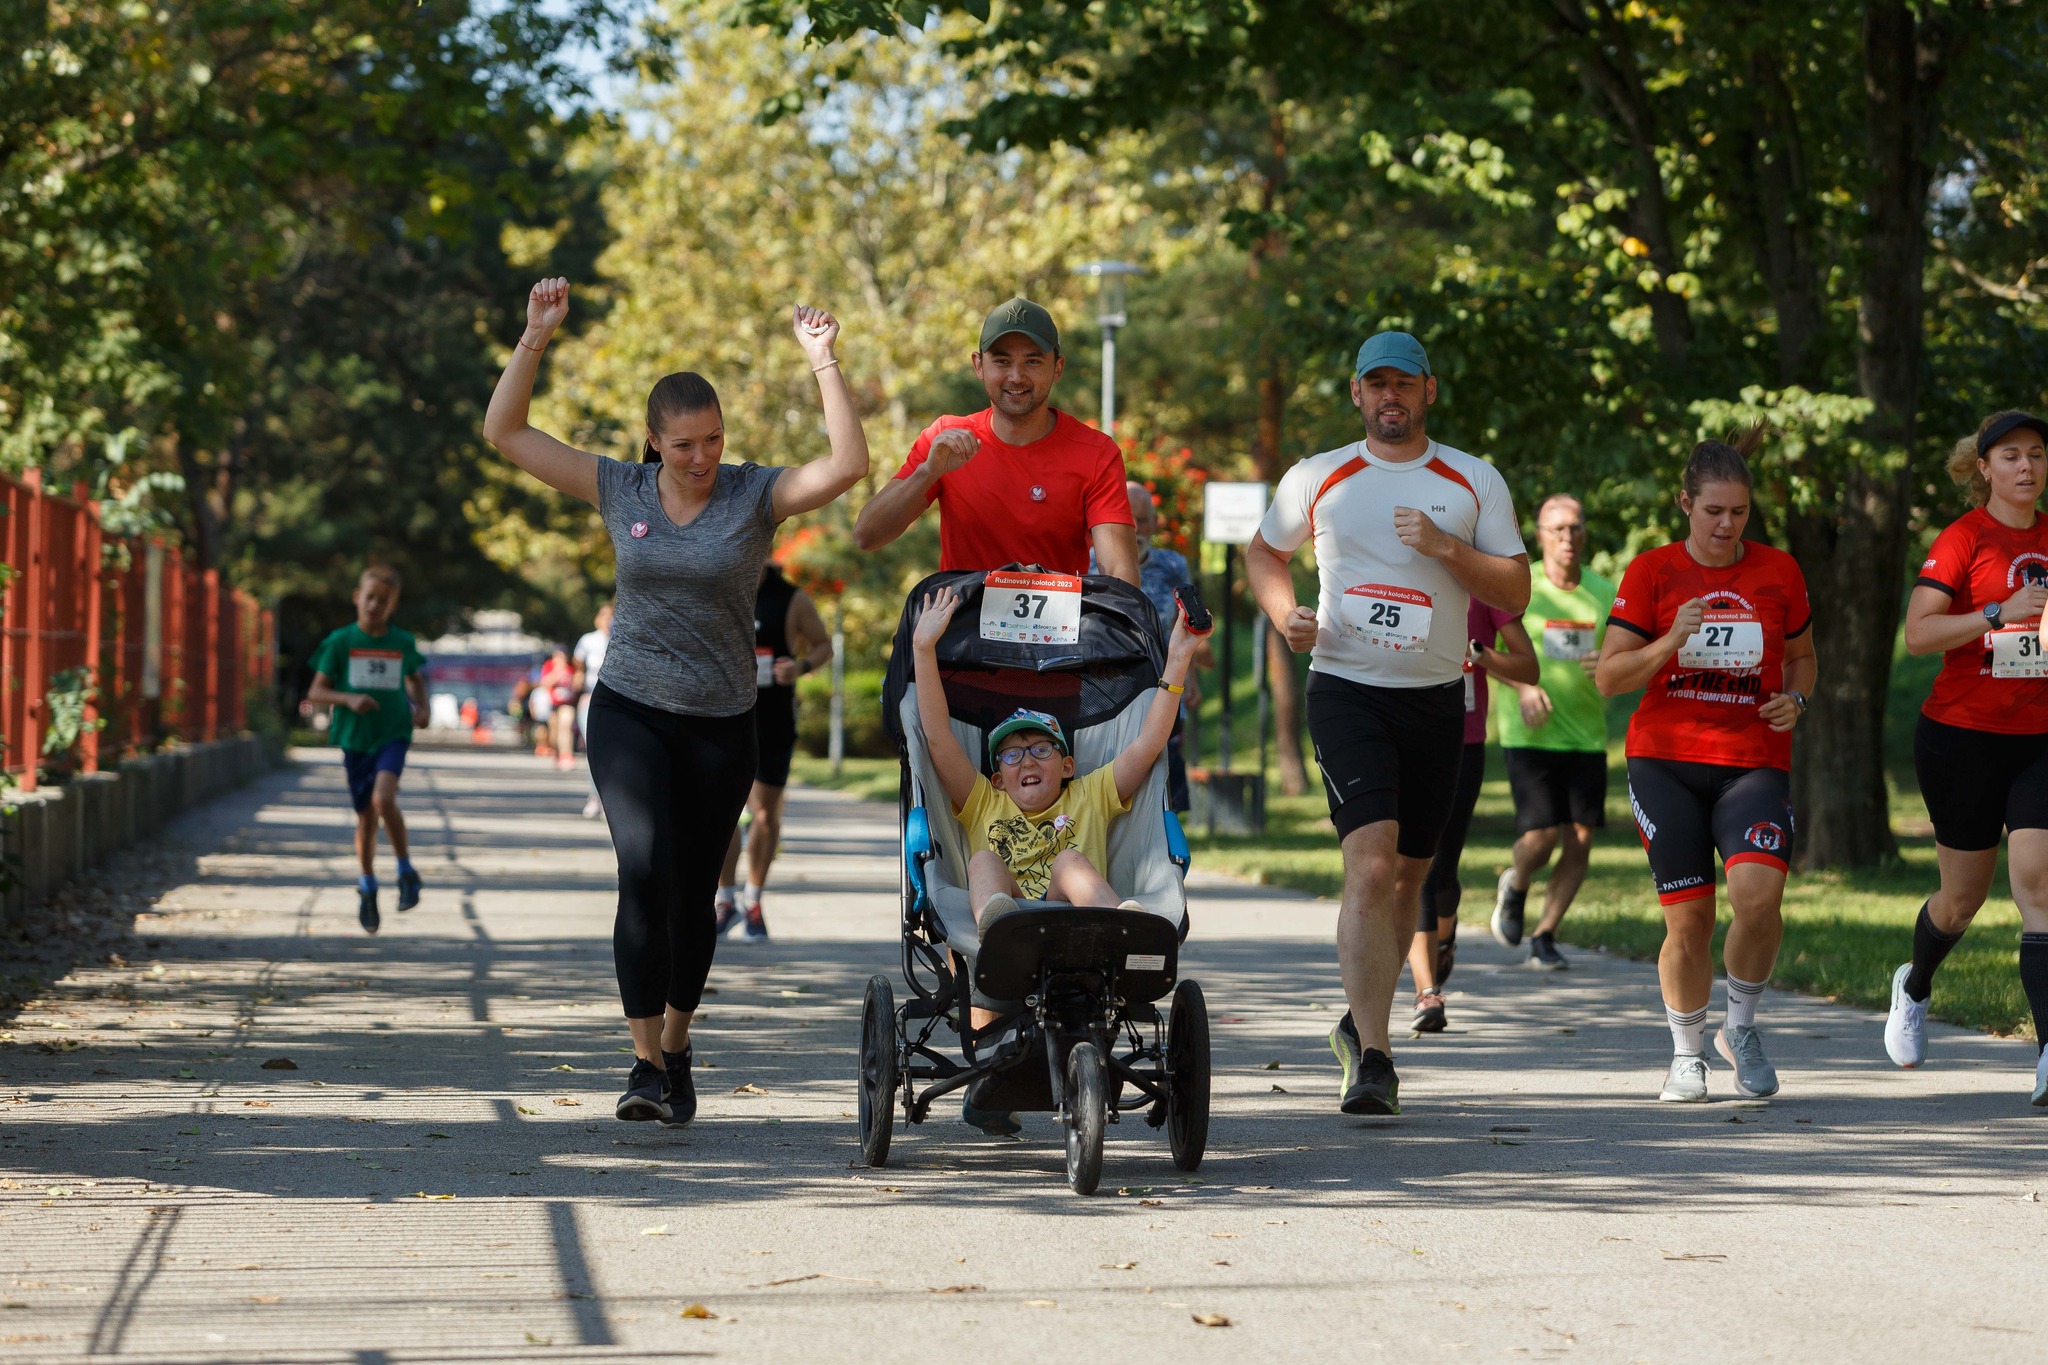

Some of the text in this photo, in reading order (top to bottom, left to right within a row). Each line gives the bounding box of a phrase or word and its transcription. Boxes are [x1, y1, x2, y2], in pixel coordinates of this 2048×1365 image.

[1431, 505, 1446, 513] HH
[994, 576, 1031, 586] Ružinovský
[1032, 579, 1056, 587] kolotoč
[1388, 591, 1411, 600] kolotoč
[1411, 594, 1426, 602] 2023
[1720, 590, 1740, 600] GROUP
[1013, 593, 1048, 619] 37
[1368, 602, 1401, 628] 25
[1705, 626, 1734, 647] 27
[2018, 635, 2041, 657] 31
[1691, 671, 1726, 691] THE
[1727, 675, 1761, 694] END
[1672, 689, 1695, 699] YOUR
[1696, 691, 1737, 704] COMFORT
[1662, 875, 1704, 892] PATRÍCIA
